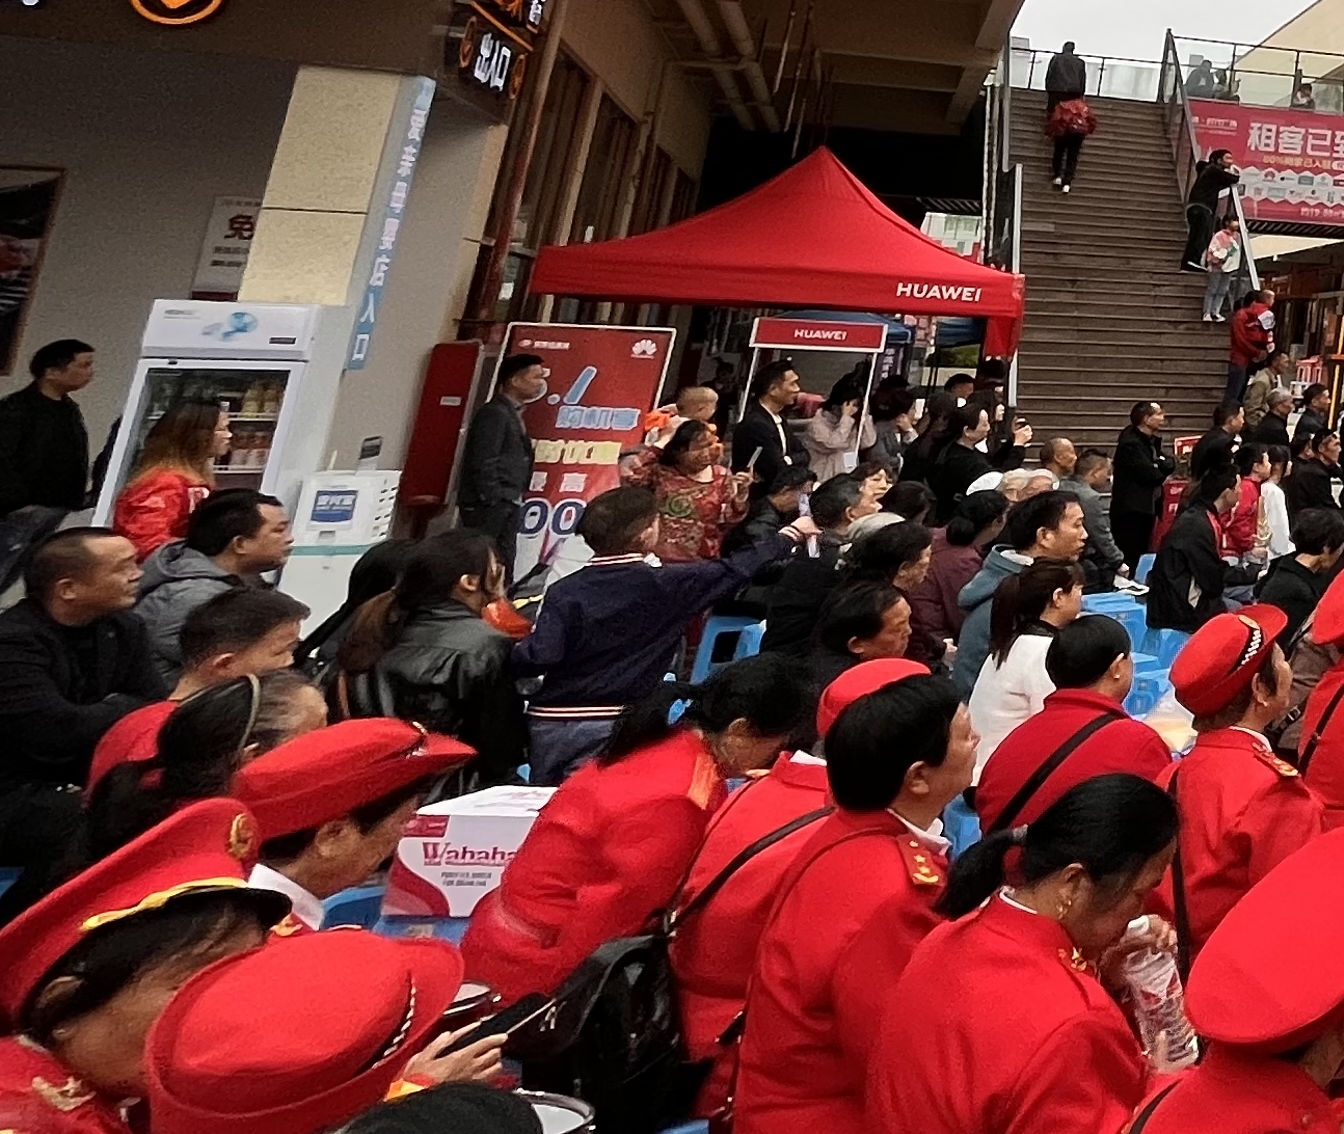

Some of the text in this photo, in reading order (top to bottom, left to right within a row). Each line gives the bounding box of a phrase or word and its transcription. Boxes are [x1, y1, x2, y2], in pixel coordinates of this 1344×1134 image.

[896, 282, 982, 303] HUAWEI
[794, 328, 847, 342] HUAWEI
[422, 841, 516, 865] Wahaha
